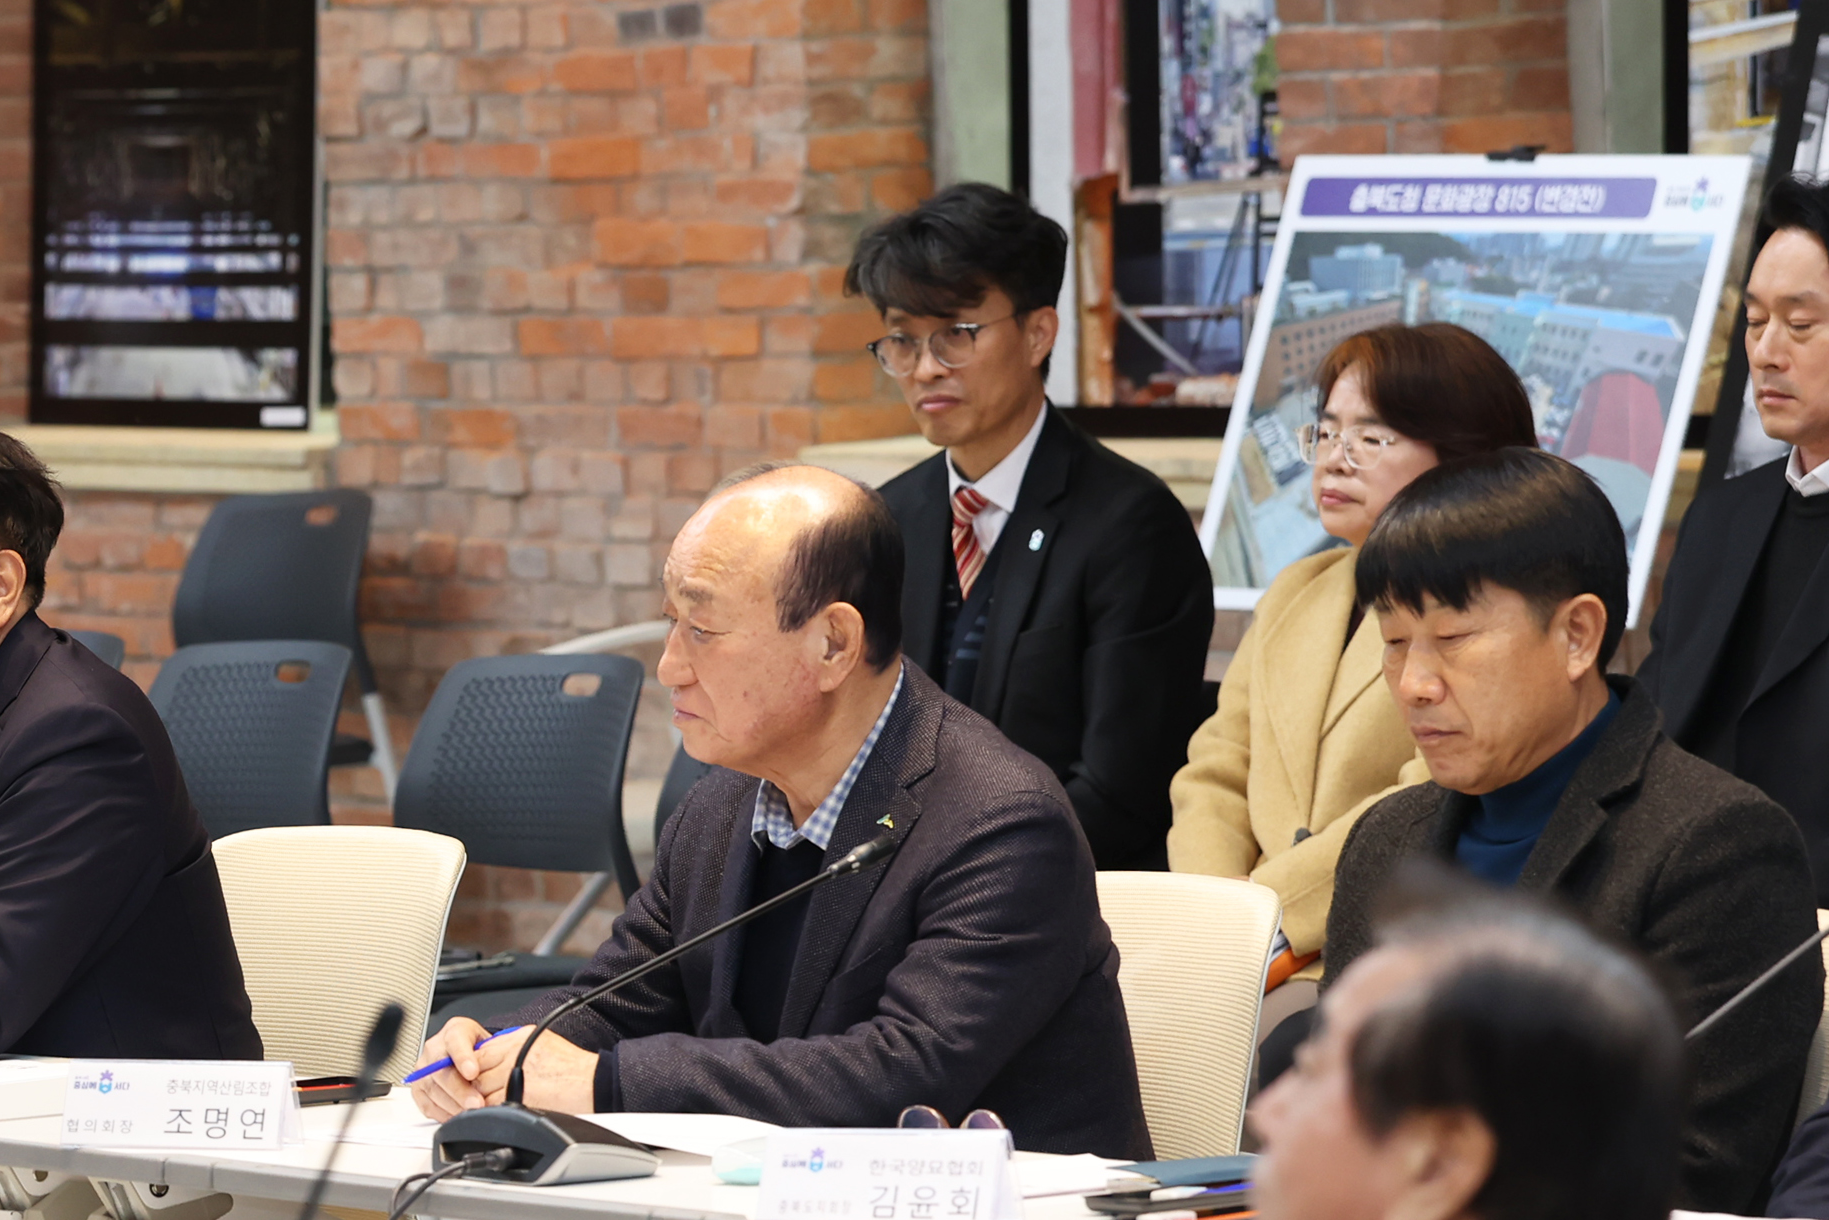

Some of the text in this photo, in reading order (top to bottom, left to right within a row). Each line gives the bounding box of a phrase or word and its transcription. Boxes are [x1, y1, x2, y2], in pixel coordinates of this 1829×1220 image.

[1349, 183, 1423, 213] 충북도청
[1421, 183, 1497, 213] 문화광장
[1494, 183, 1534, 213] 815
[166, 1079, 272, 1097] 충북지역산림조합
[66, 1118, 134, 1134] 협의회장
[163, 1107, 266, 1140] 조명연
[869, 1185, 981, 1220] 김윤회
